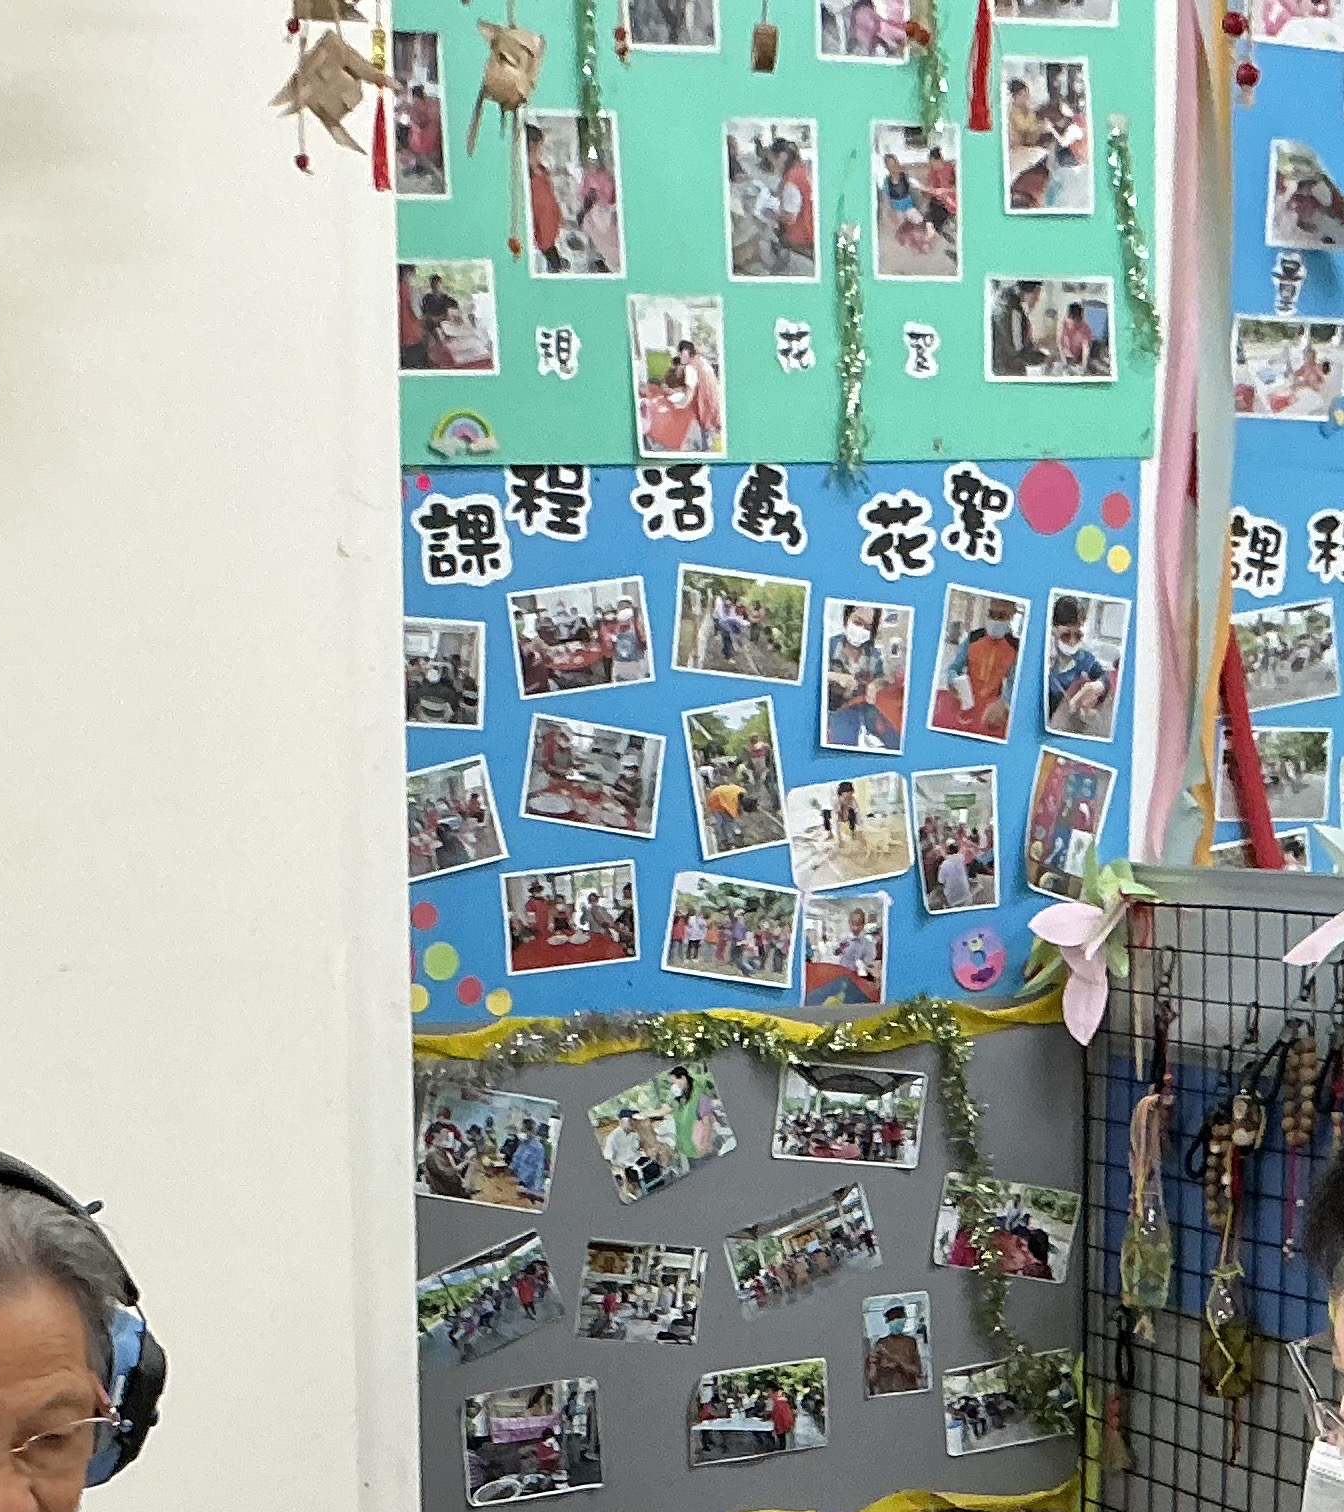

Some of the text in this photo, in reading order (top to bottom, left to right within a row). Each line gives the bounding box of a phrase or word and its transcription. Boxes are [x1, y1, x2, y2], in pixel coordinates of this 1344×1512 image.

[778, 328, 811, 370] 花
[418, 463, 1011, 578] 課程活動花絮
